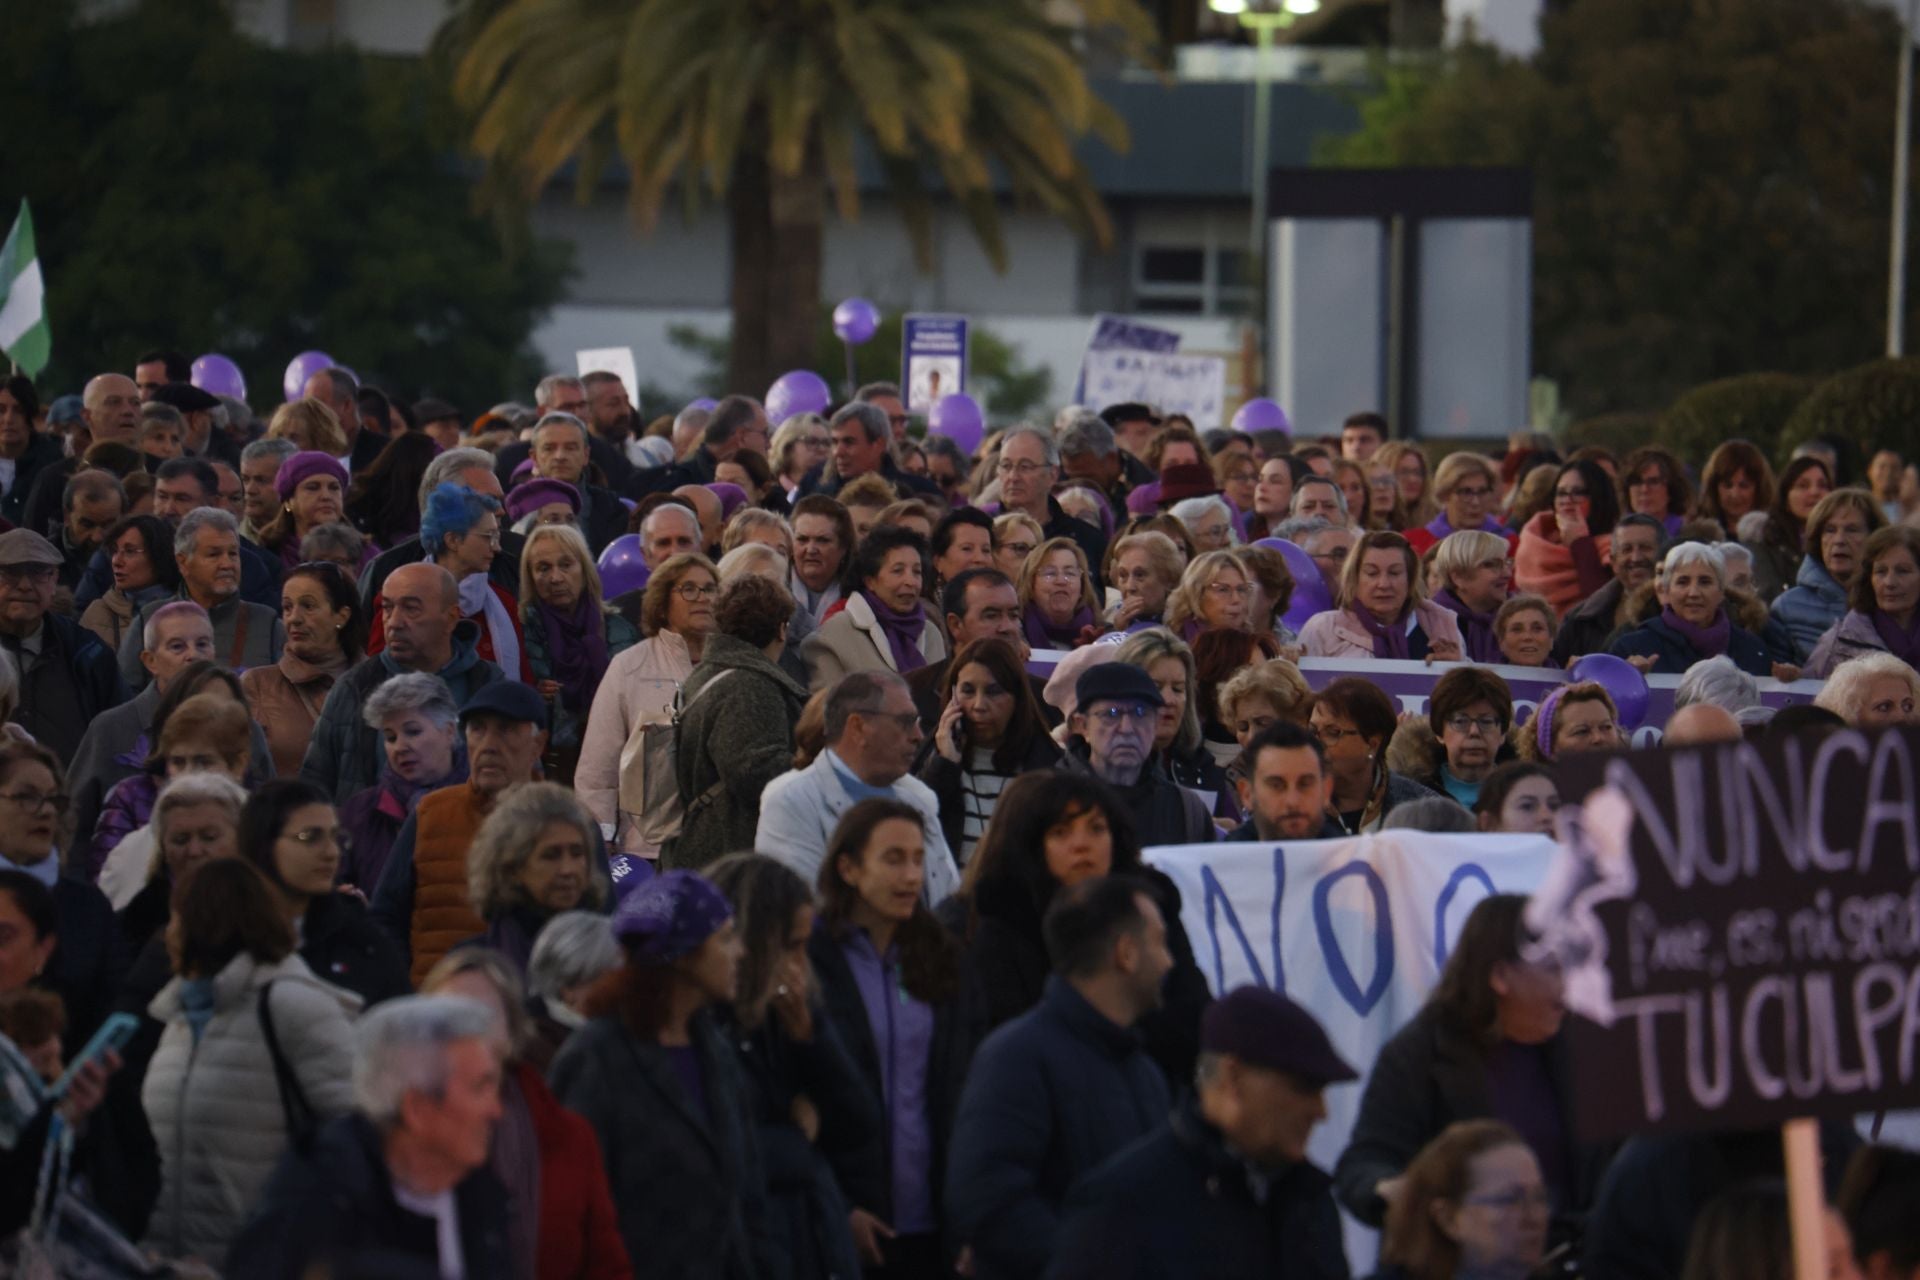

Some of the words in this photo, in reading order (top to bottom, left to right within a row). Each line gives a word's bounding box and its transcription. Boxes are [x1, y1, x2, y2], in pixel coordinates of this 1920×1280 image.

[1605, 728, 1920, 888] NUNCA
[1788, 888, 1843, 961] ni
[1611, 983, 1732, 1120] TU
